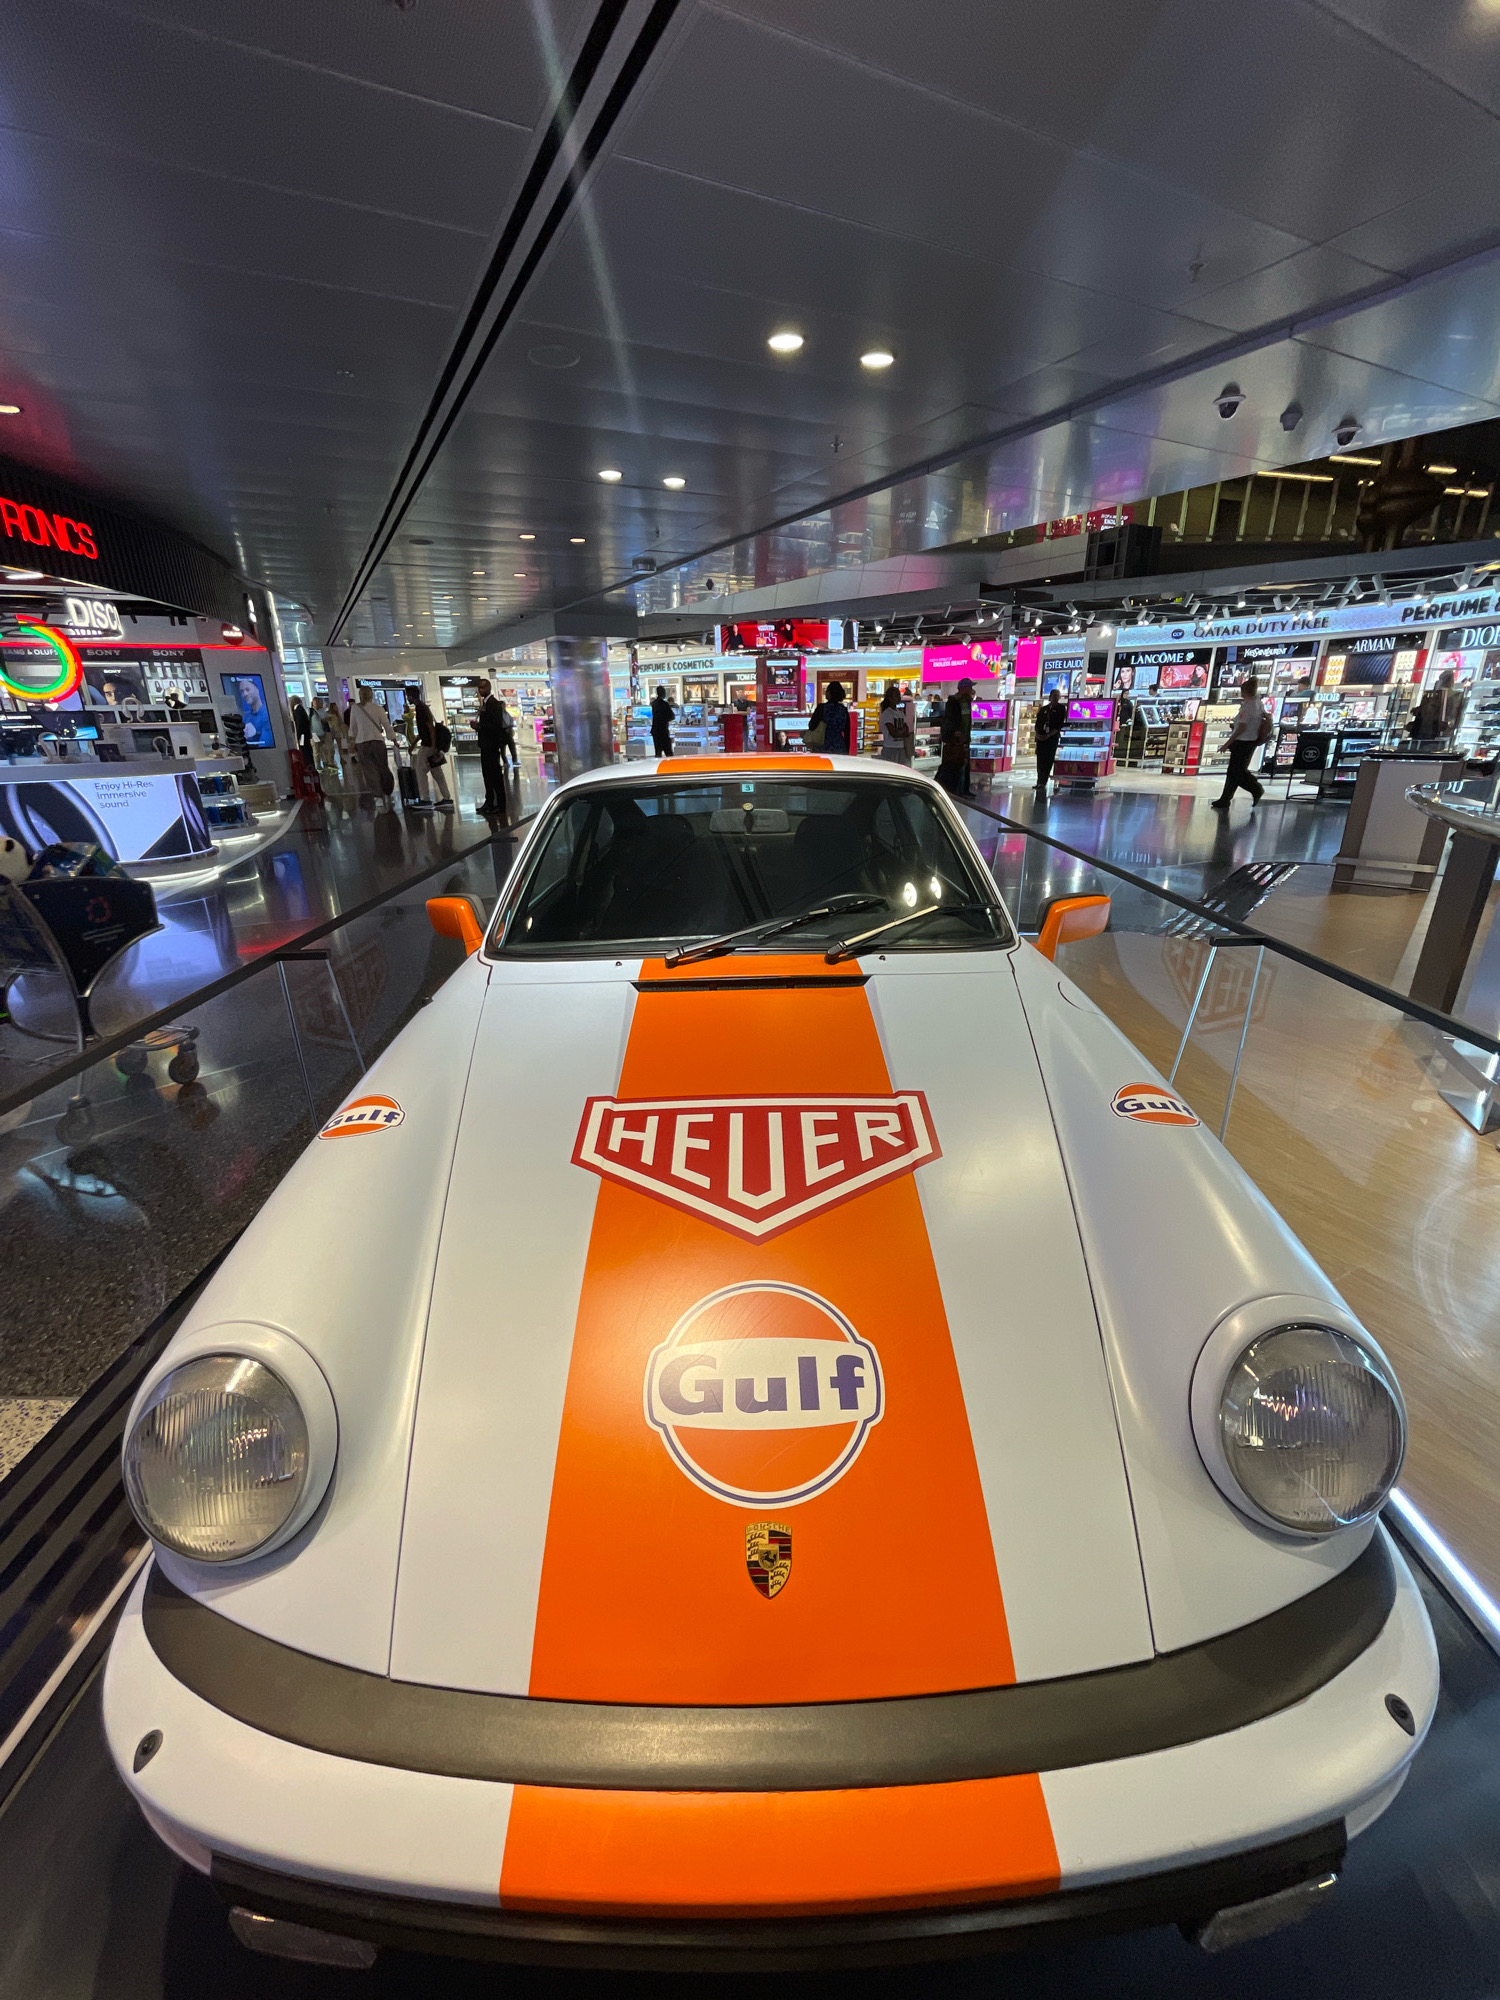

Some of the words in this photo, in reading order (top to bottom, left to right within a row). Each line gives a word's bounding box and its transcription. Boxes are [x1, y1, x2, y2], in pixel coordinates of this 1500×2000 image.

[1401, 596, 1491, 622] PERFUME
[1193, 624, 1241, 638] QATAR
[1245, 620, 1289, 635] DUTY
[1291, 616, 1329, 631] FREE
[1352, 636, 1397, 653] ARMANI
[667, 662, 672, 671] &
[673, 659, 714, 671] COSMETICS
[1131, 652, 1184, 665] LANCÔME
[1316, 692, 1340, 701] DIOR
[94, 782, 120, 792] Enjoy
[122, 780, 153, 789] Hi-Res
[97, 791, 147, 800] immersive
[99, 800, 129, 809] sound
[321, 1109, 400, 1132] Gulf
[607, 1111, 905, 1210] HEUER
[658, 1353, 865, 1416] Gulf
[746, 1522, 791, 1534] PORSCHE
